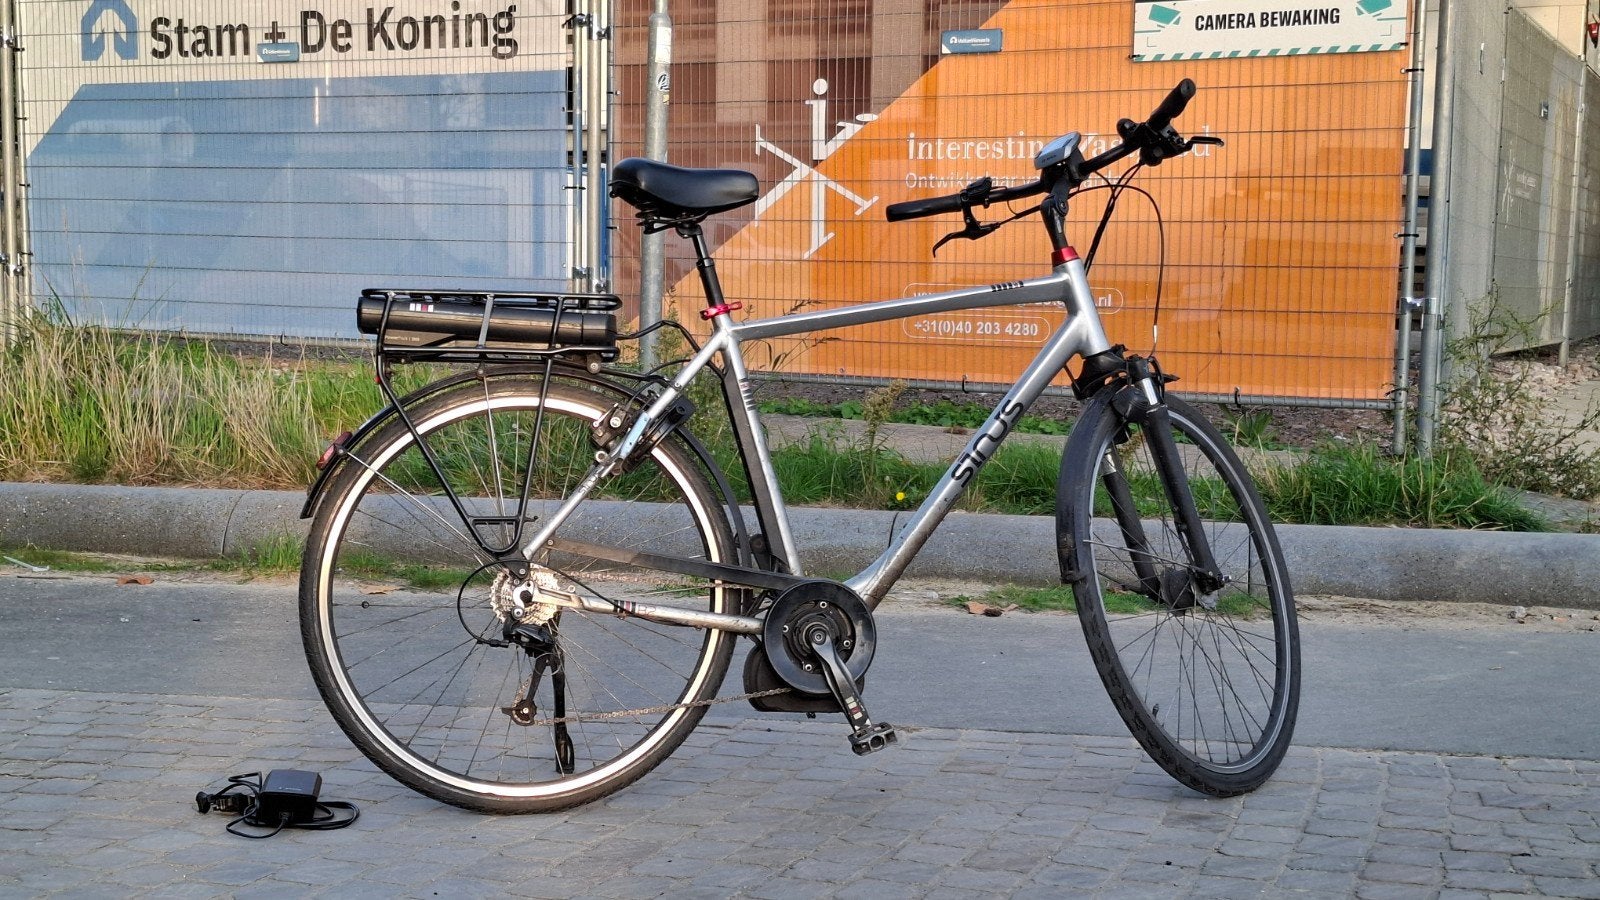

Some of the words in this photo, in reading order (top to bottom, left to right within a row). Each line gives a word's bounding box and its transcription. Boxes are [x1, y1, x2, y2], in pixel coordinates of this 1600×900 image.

[150, 16, 250, 60] Stam
[300, 10, 353, 54] De
[366, 1, 519, 60] Koning
[1194, 12, 1257, 32] CAMERA
[1259, 7, 1341, 28] BEWAKING
[913, 319, 972, 336] +31(0)40
[976, 321, 1001, 335] 203
[1004, 322, 1039, 336] 4280
